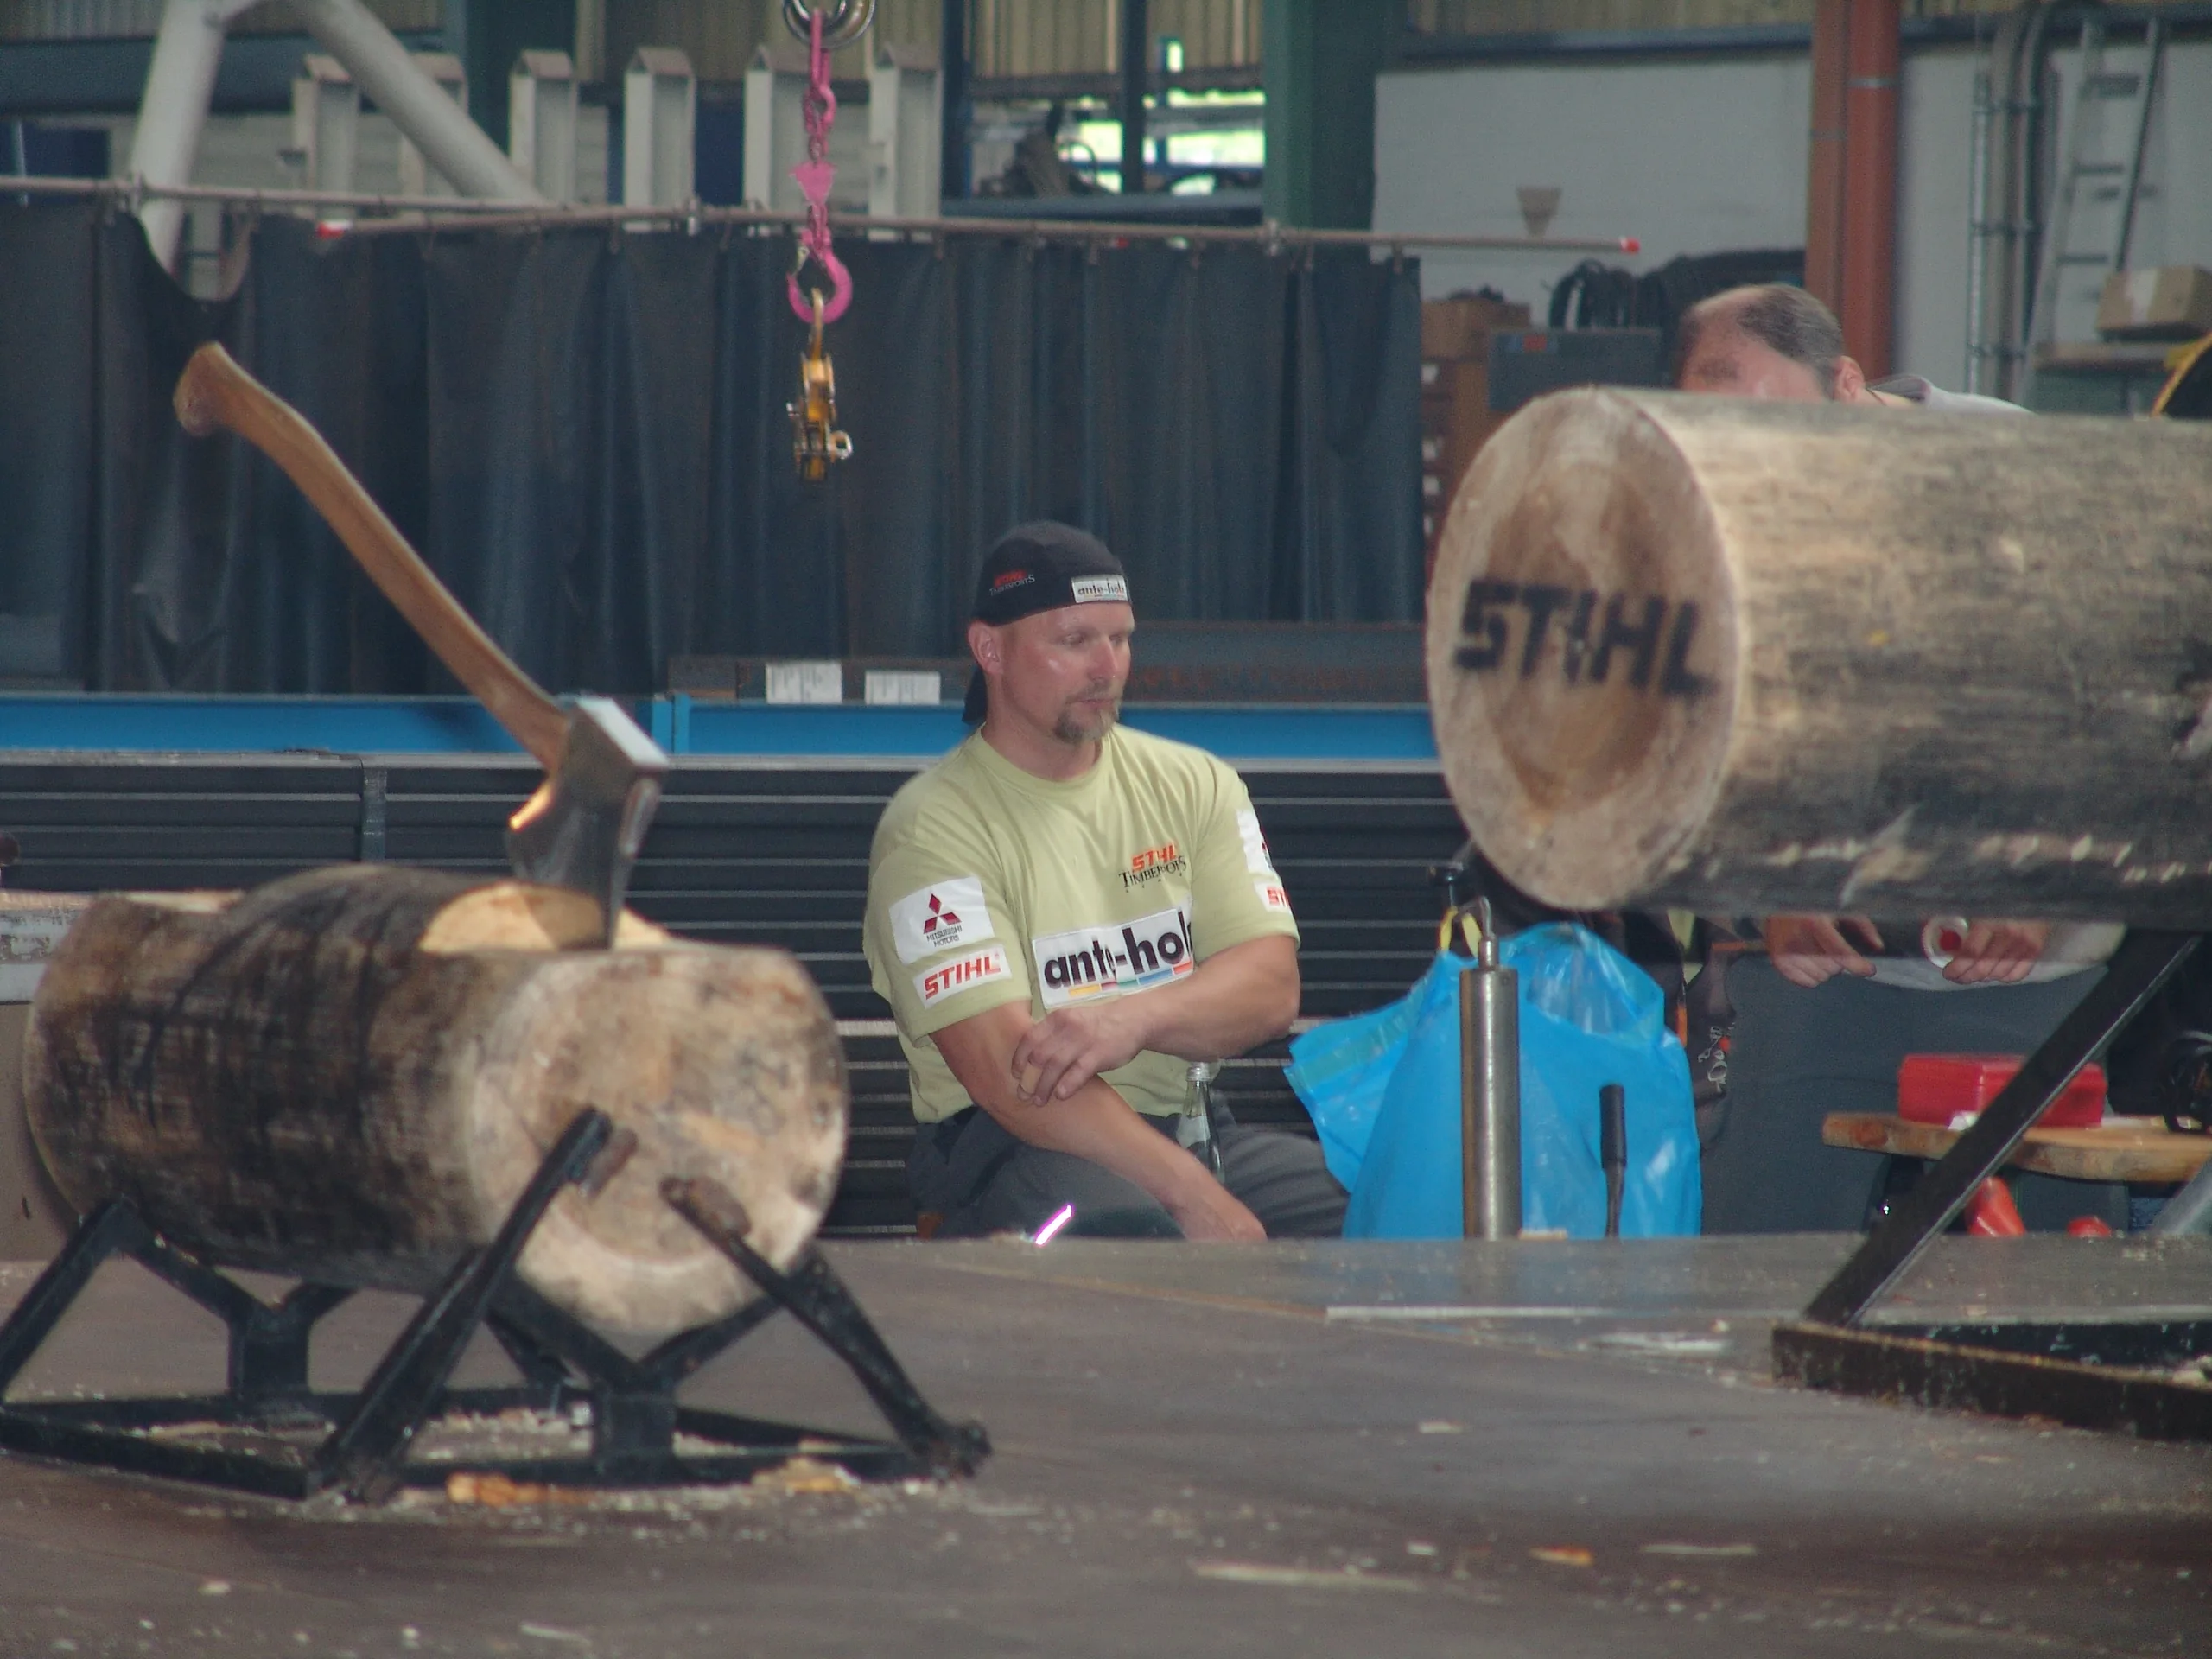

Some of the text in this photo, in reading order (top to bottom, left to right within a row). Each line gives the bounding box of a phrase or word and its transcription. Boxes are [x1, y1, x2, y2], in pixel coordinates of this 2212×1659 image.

[1453, 579, 1721, 696] STIHL
[1132, 844, 1176, 873] STHL
[926, 925, 963, 942] MITSUBISHI
[933, 934, 959, 947] MOTORS
[1044, 911, 1193, 989] ante-hol
[924, 956, 1001, 1000] STIHL
